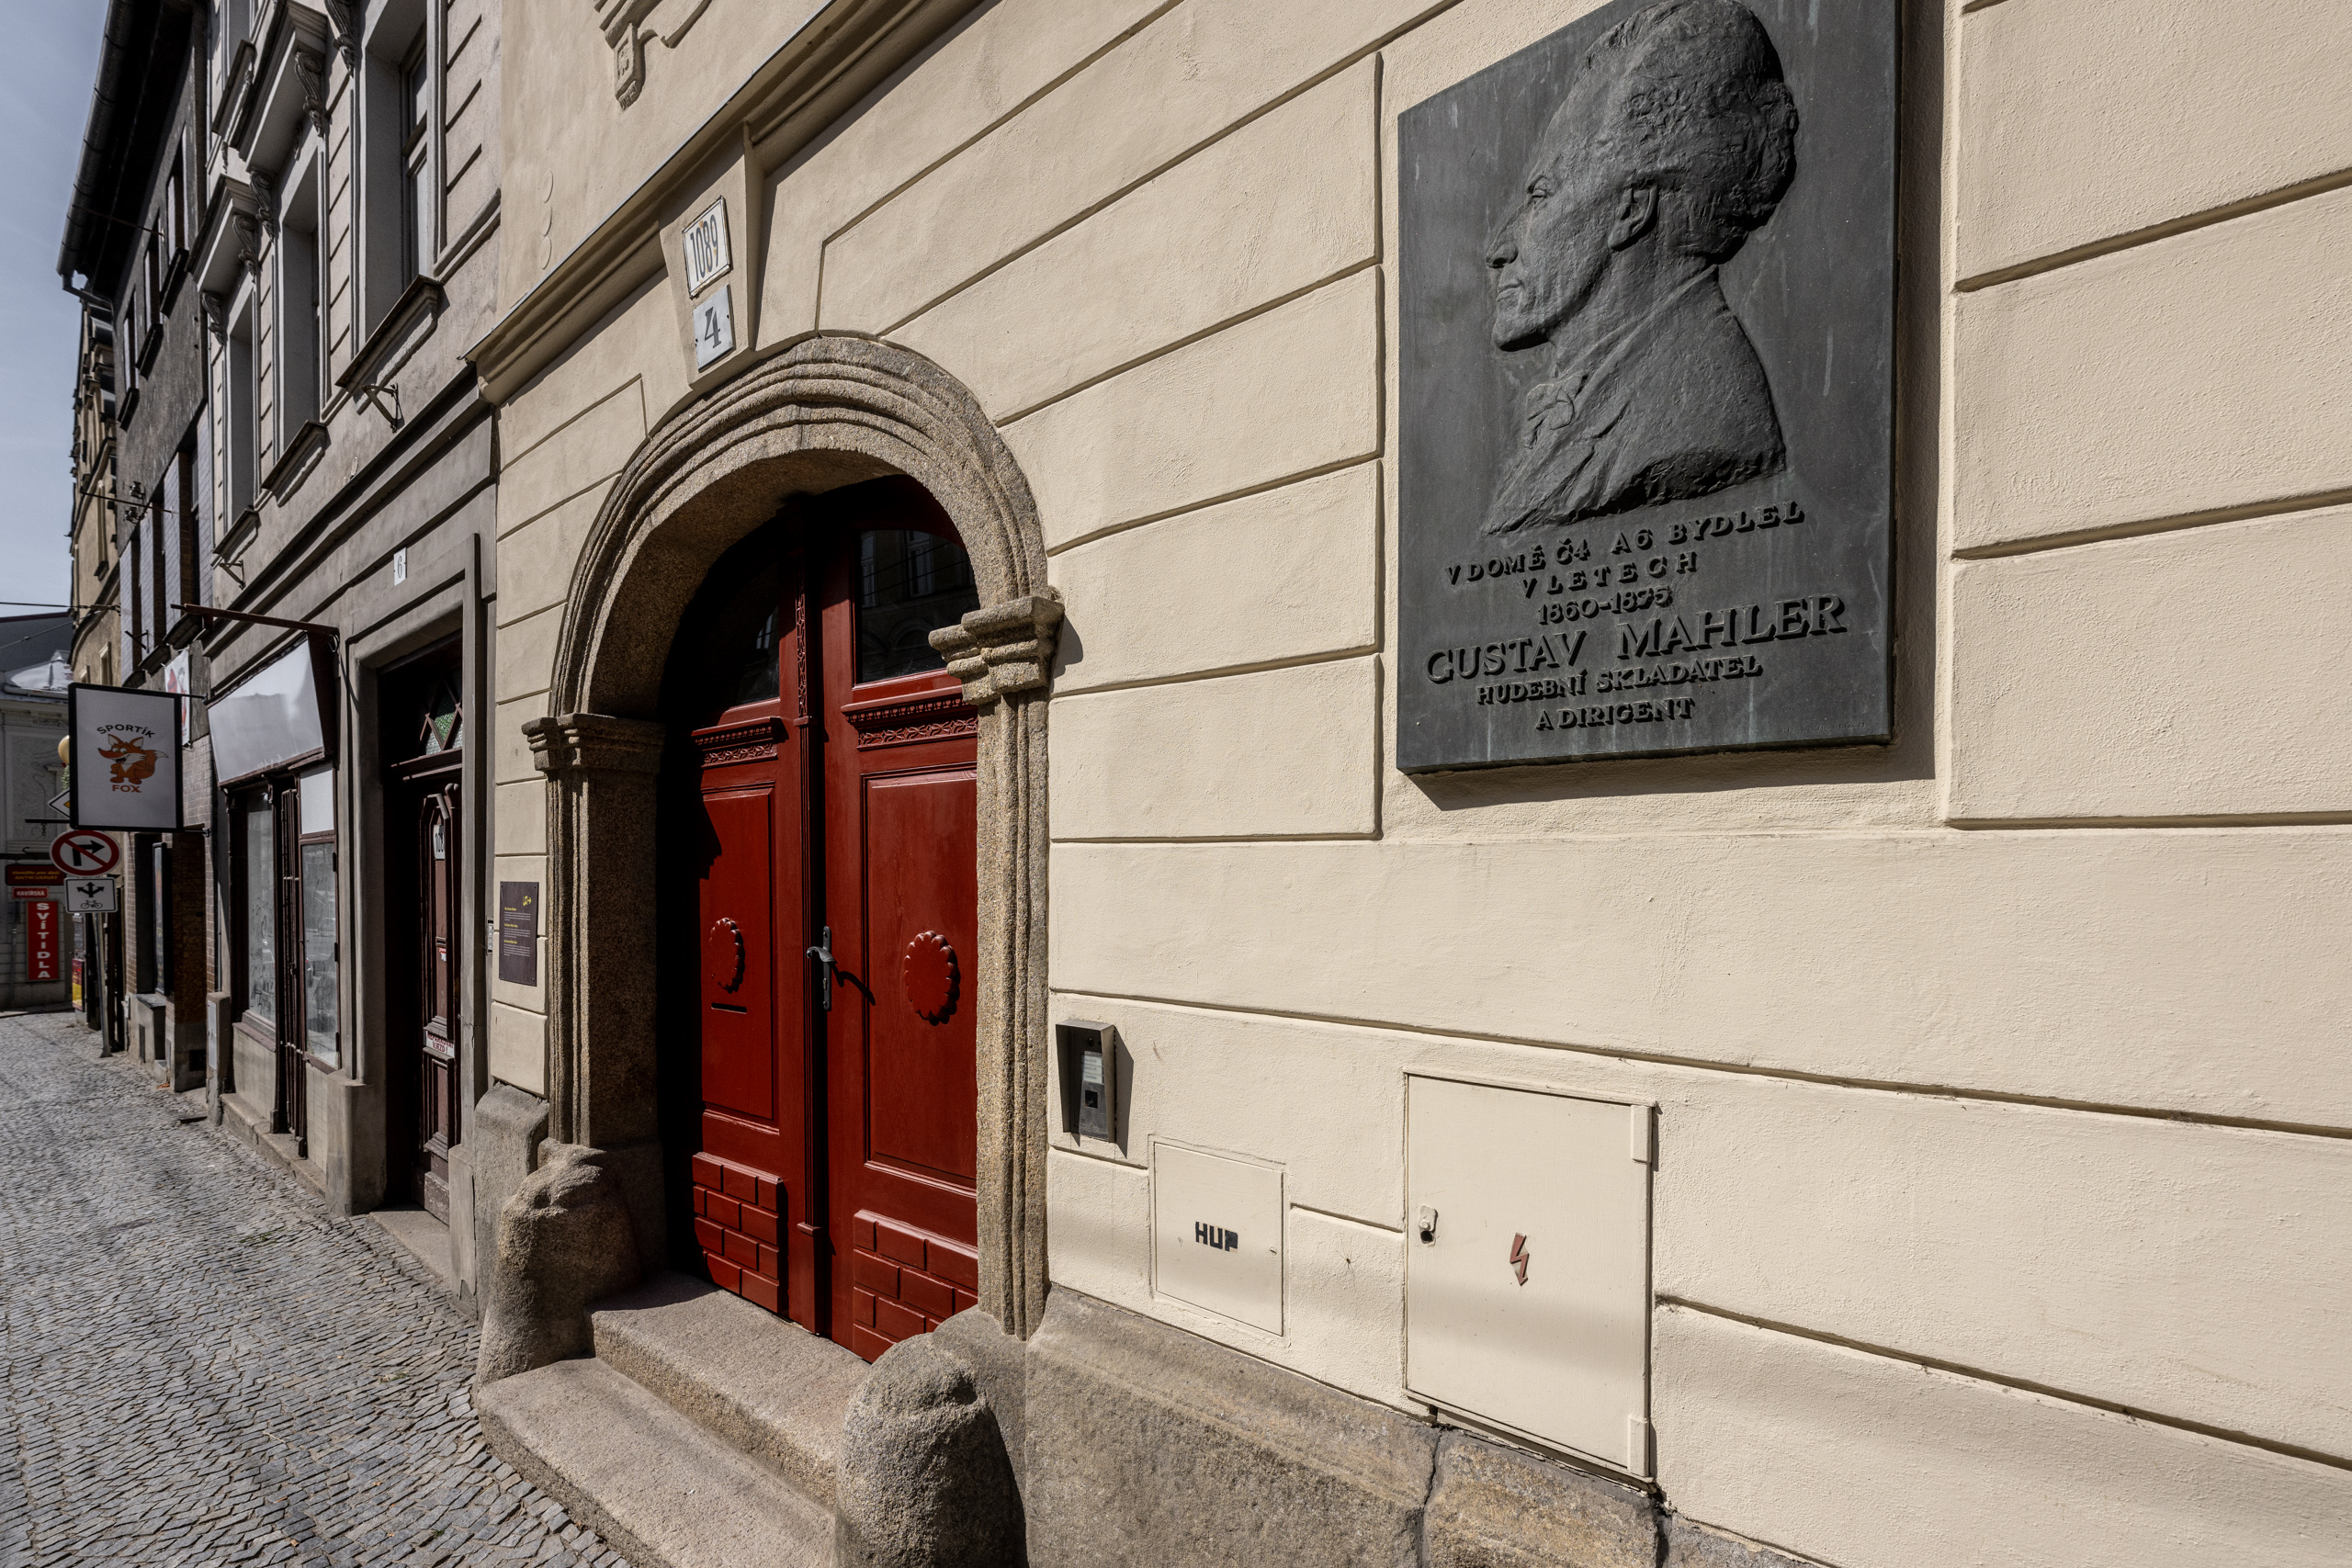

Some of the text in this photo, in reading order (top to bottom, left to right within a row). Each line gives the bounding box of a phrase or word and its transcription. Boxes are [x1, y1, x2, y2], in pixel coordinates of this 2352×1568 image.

[690, 214, 718, 282] 1089
[705, 307, 721, 348] 4
[1668, 501, 1804, 545] BYDLEL
[398, 556, 402, 579] 6
[1521, 551, 1697, 599] V LETECH
[1538, 585, 1673, 625] 1860-1875
[1426, 594, 1848, 683] GUSTAV MAHLER
[1476, 655, 1763, 705] HUDEBNÍ SKLADATEL
[96, 724, 155, 739] SPORTÍK
[1557, 696, 1695, 728] DIRIGENT
[112, 784, 141, 794] FOX
[37, 902, 51, 978] SVÍTIDLA
